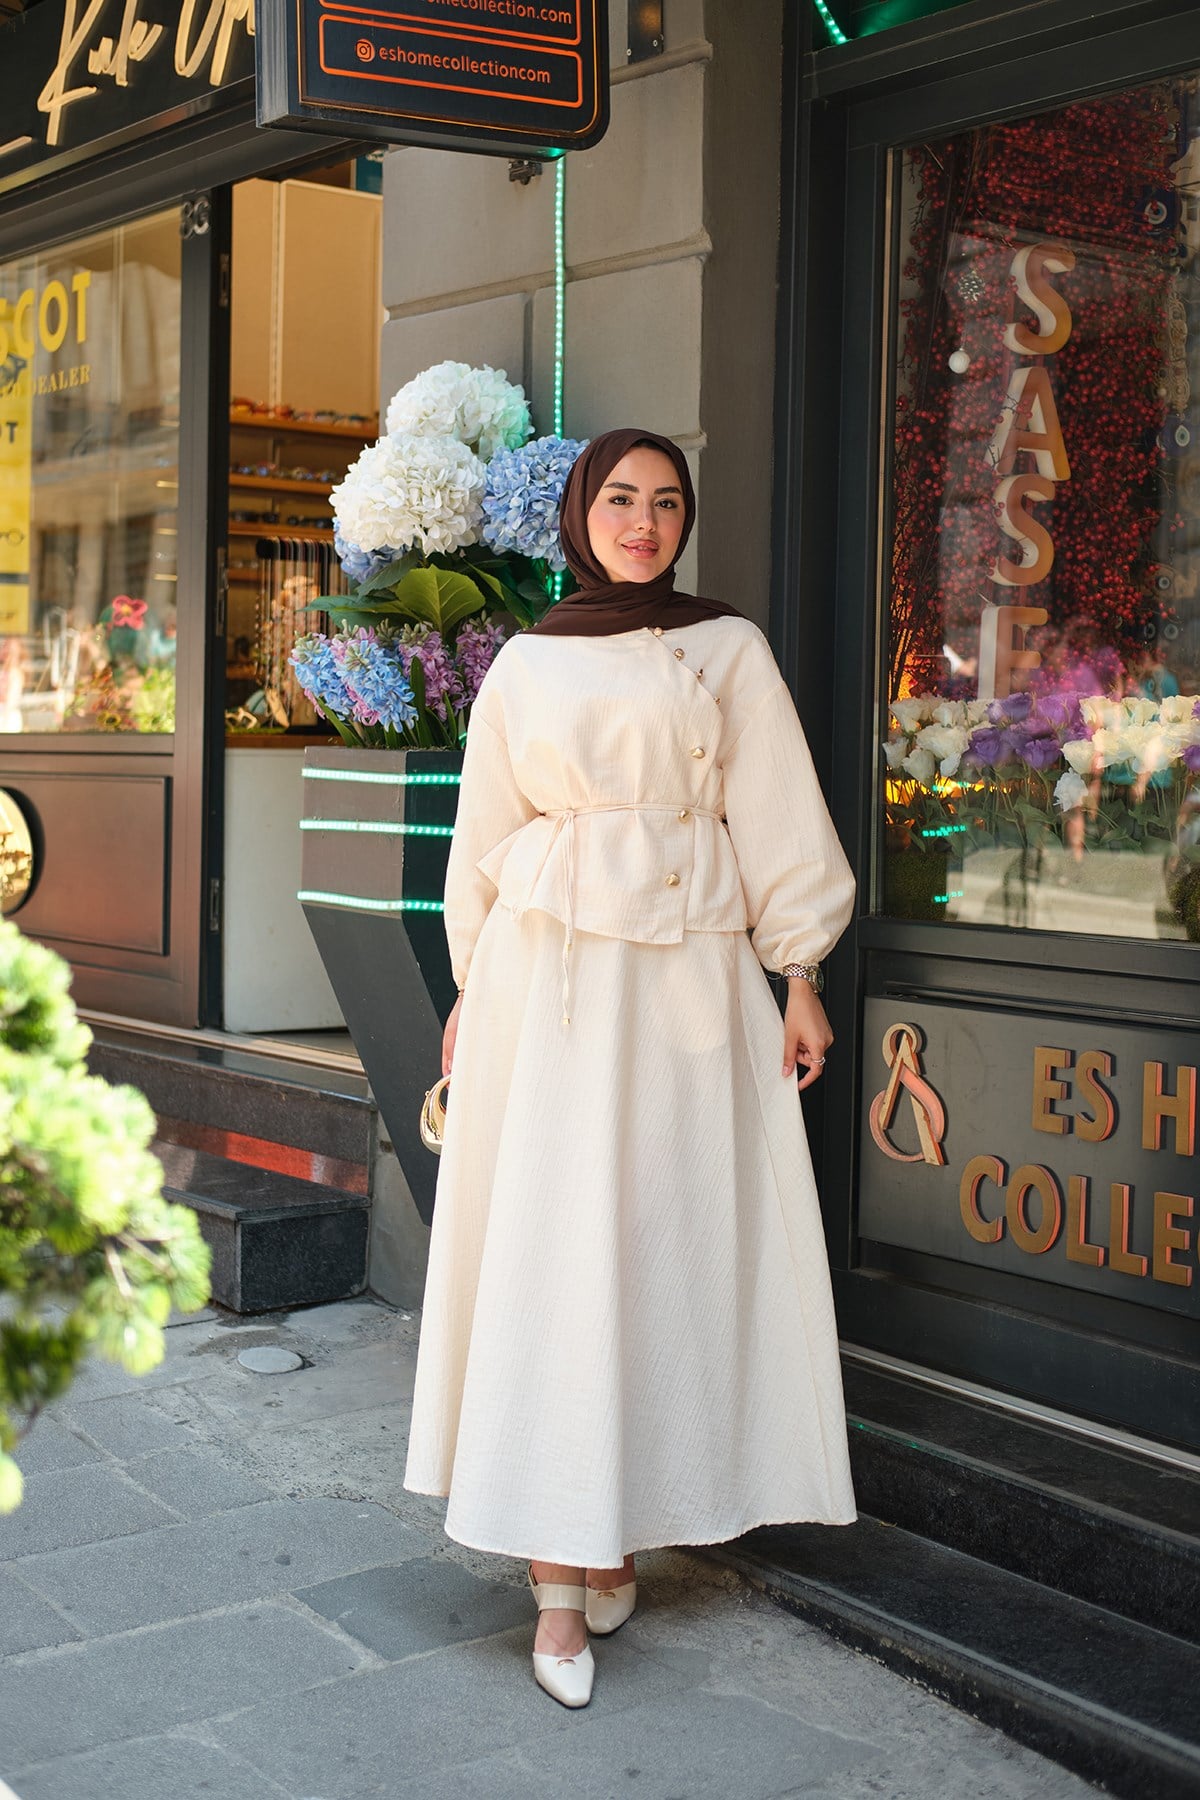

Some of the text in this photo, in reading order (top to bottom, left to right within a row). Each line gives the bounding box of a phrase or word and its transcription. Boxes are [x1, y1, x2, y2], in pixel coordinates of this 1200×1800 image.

[379, 44, 551, 84] eshomecollectioncom
[1031, 1046, 1114, 1142] ES
[959, 1155, 1200, 1287] COLLE
